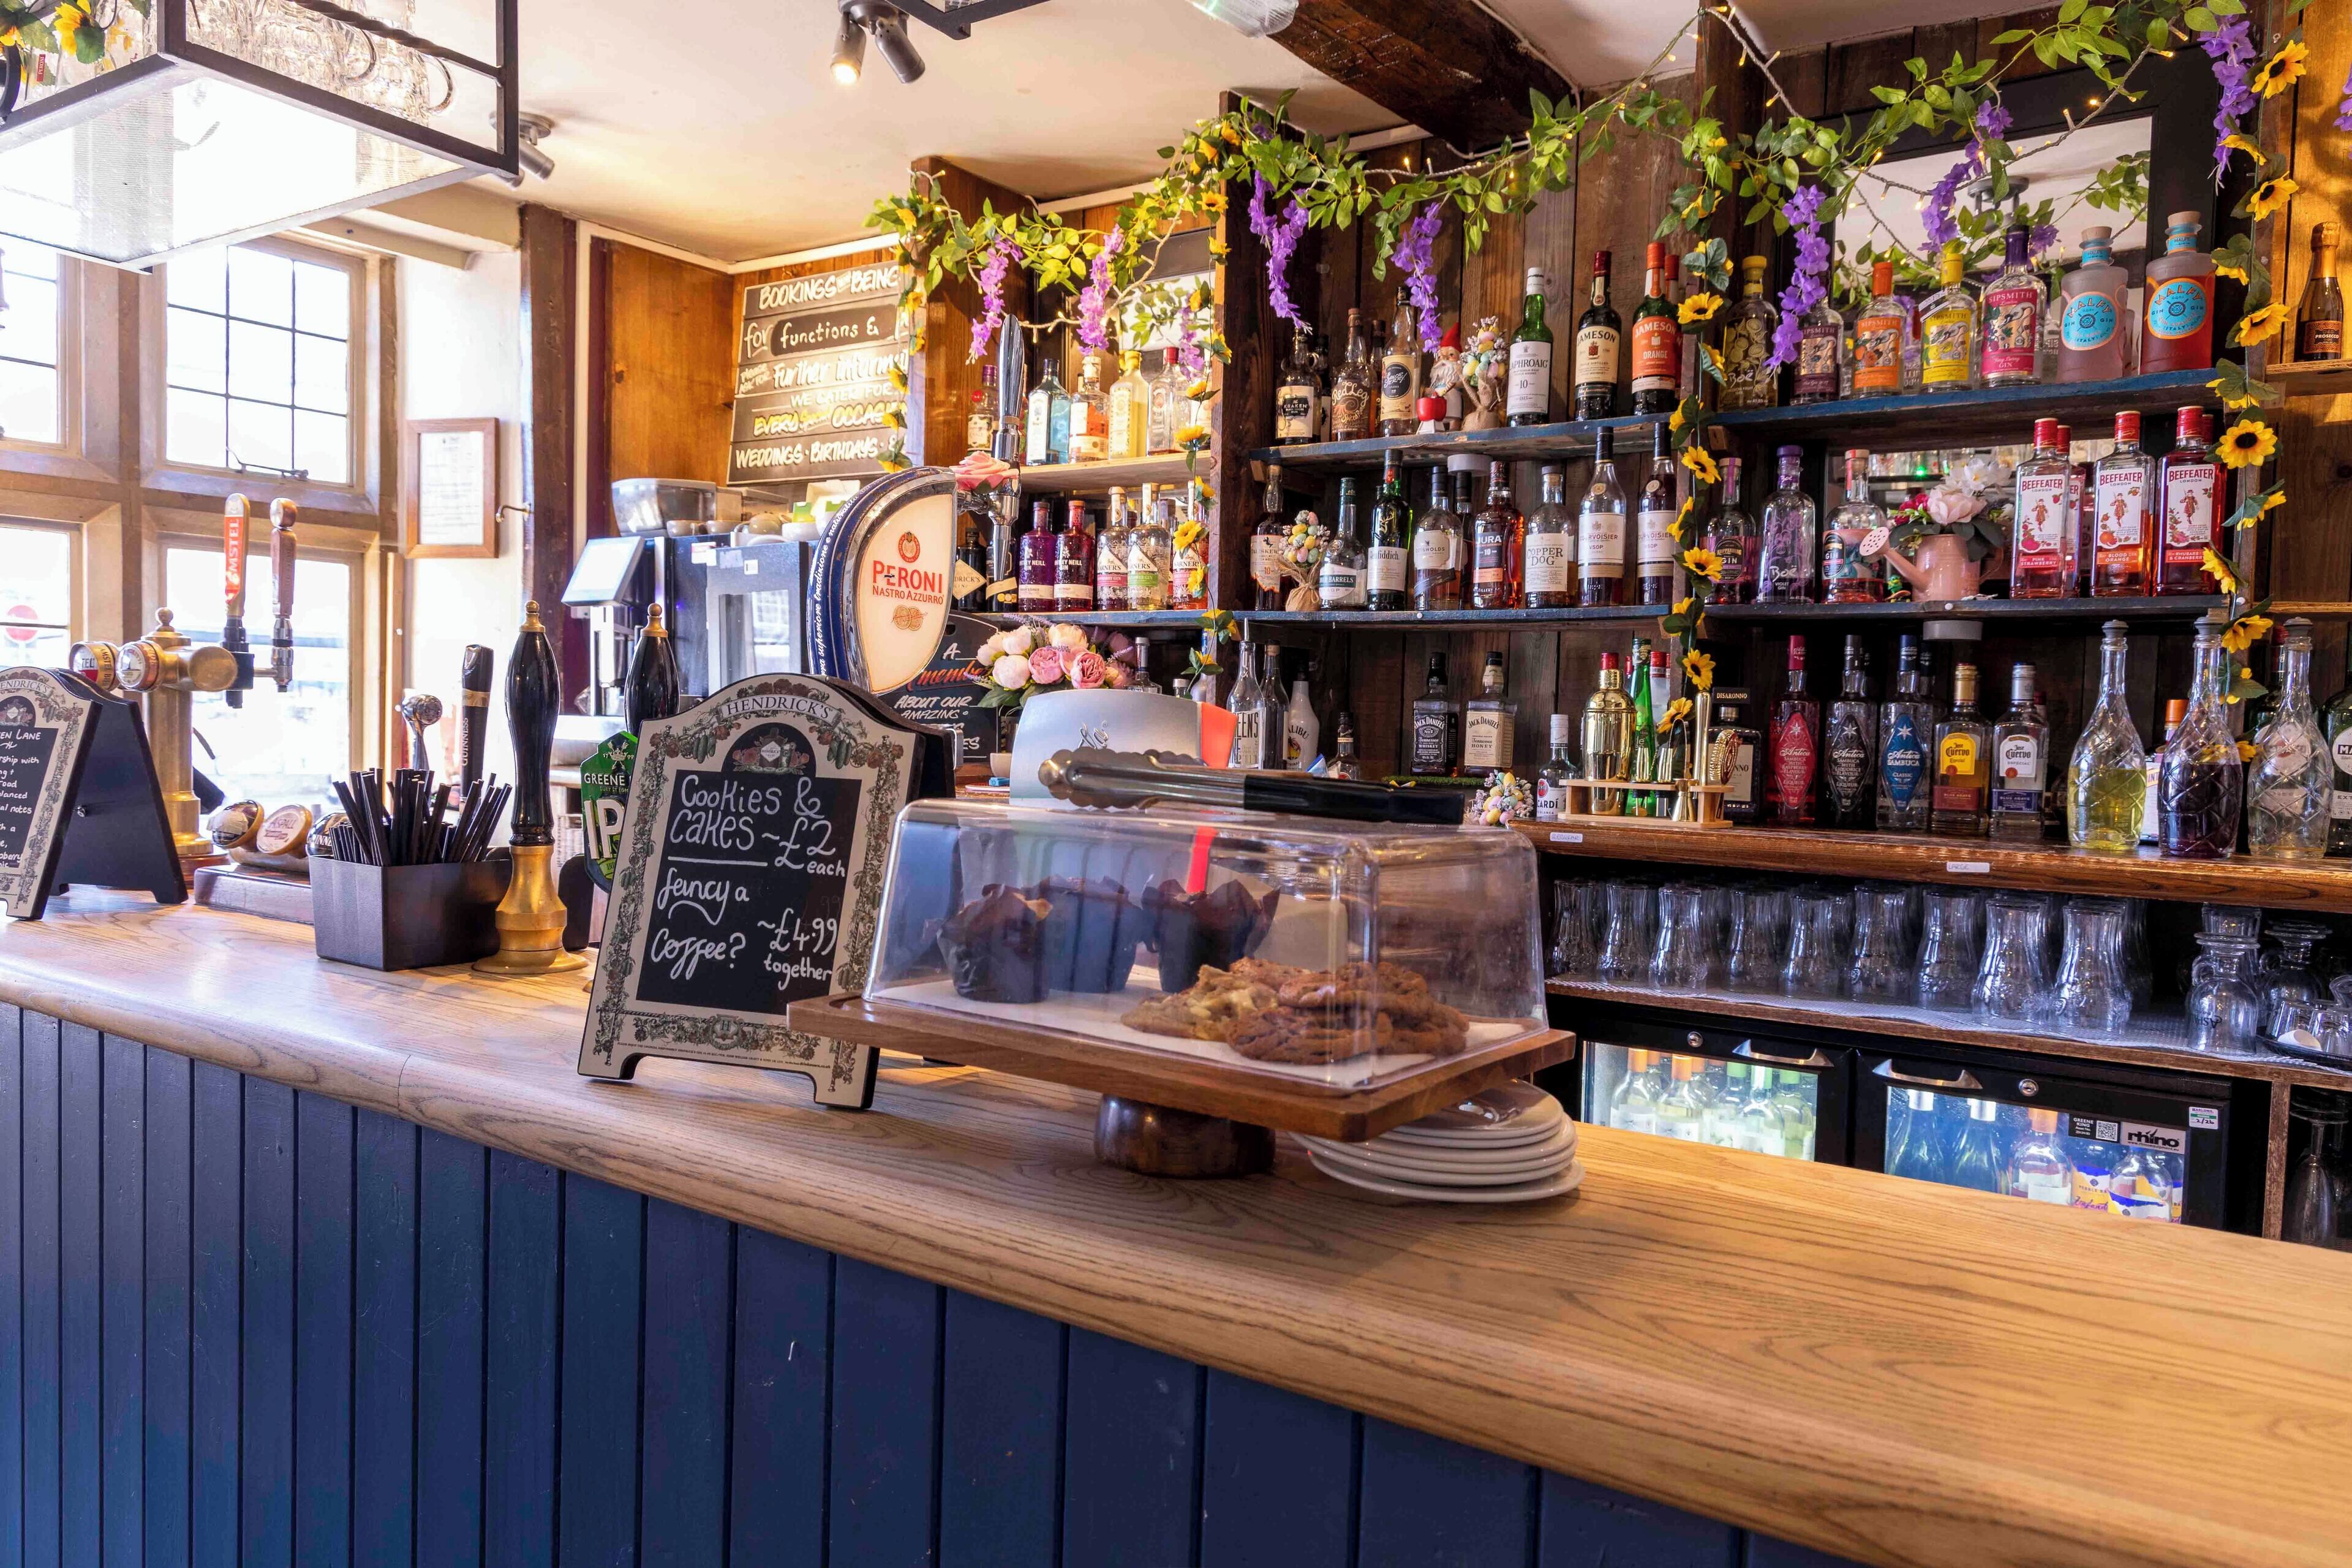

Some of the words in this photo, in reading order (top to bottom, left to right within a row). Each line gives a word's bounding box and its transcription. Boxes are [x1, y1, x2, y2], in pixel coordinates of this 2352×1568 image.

[760, 276, 837, 310] BOOKINGS
[1988, 292, 2033, 303] SIPSMITH
[2154, 284, 2202, 306] MALFY
[2067, 298, 2113, 318] MALFY
[1634, 321, 1676, 339] JAMESON
[1861, 318, 1898, 328] SIPSMITH
[780, 322, 858, 349] functions
[867, 316, 878, 335] &
[1577, 330, 1616, 347] JAMESON
[1643, 350, 1668, 360] ORANGE
[1520, 379, 1528, 389] 10
[791, 395, 812, 408] WE
[736, 443, 804, 469] WEDDINGS
[810, 435, 879, 464] BIRTHDAYS
[2100, 472, 2143, 486] BEEFEATER
[2169, 469, 2214, 483] BEEFEATER
[2021, 479, 2063, 491] BEEFEATER
[1477, 535, 1502, 545] JURA
[1527, 547, 1564, 558] COPPER
[1531, 556, 1555, 566] DOG
[872, 560, 943, 594] PERONI
[1769, 565, 1798, 582] Boë
[872, 584, 906, 600] NASTRO
[906, 586, 944, 605] AZZURRO
[942, 643, 961, 660] A
[0, 680, 49, 693] ENDRICK'S
[726, 696, 832, 720] HENDRICK'S
[894, 695, 941, 709] ABOUT
[940, 696, 973, 707] OUR
[901, 709, 960, 720] AMAZING
[1414, 718, 1427, 729] JACK
[1427, 717, 1446, 729] DANIEL'S
[1468, 718, 1480, 729] JACK
[1480, 716, 1500, 729] DANIEL'S
[16, 729, 42, 740] LANE
[1779, 746, 1811, 757] Antica
[1833, 749, 1866, 759] Antica
[1888, 749, 1921, 760] Antica
[1945, 747, 1970, 757] Cuervo
[2005, 748, 2032, 760] Cuervo
[584, 772, 626, 786] GREENE
[680, 774, 783, 816] Cookies
[793, 777, 825, 820] &
[10, 806, 32, 815] notes
[583, 798, 626, 859] IP
[807, 859, 846, 878] each
[734, 886, 750, 902] a
[764, 952, 832, 991] together
[2127, 1128, 2180, 1148] rhino
